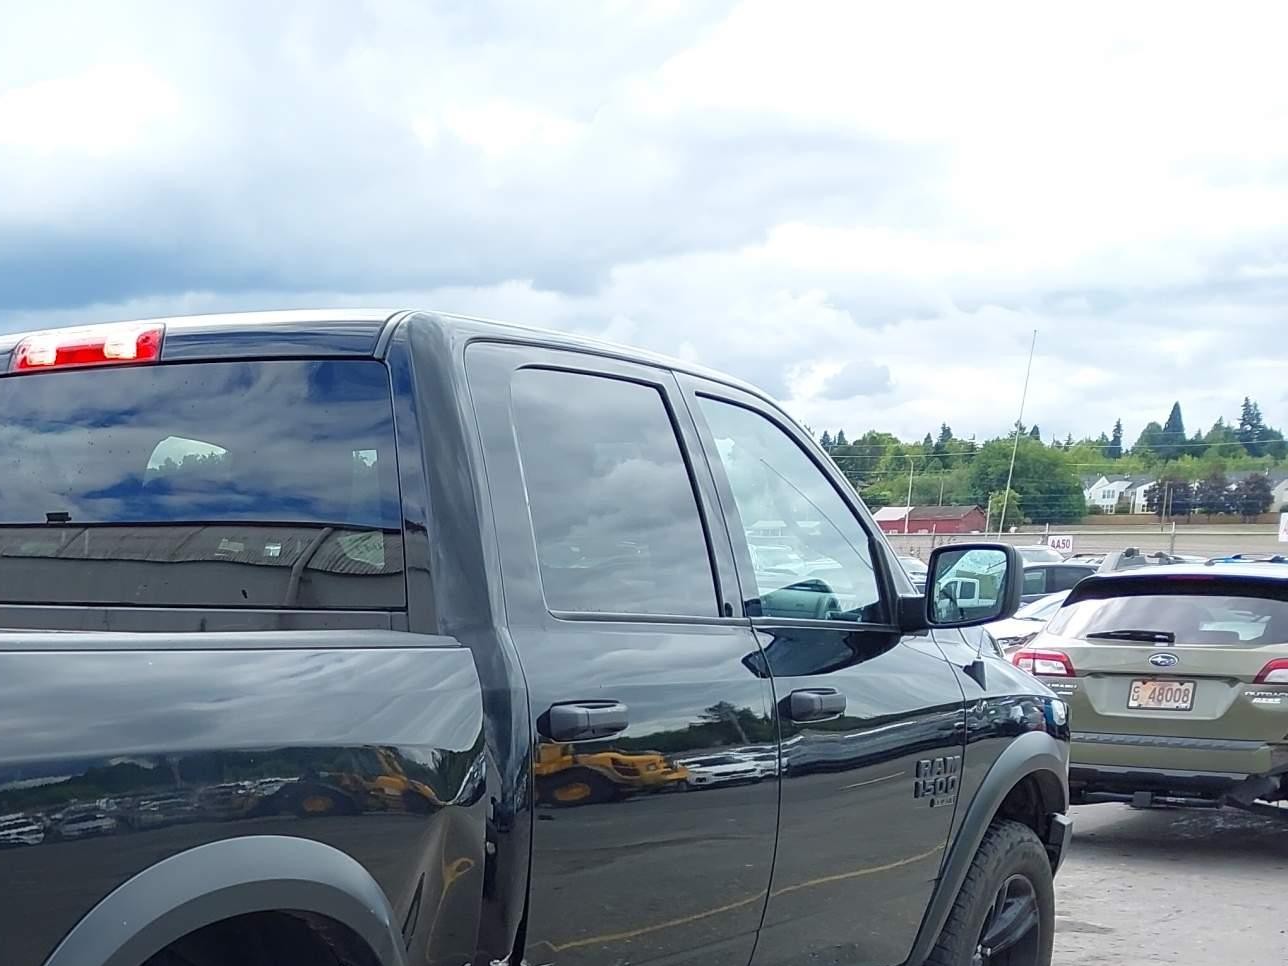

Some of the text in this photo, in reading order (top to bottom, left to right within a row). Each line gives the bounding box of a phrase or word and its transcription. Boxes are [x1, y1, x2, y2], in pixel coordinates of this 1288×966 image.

[1148, 687, 1191, 704] 48008
[915, 755, 961, 778] RAM
[913, 775, 958, 799] 1500
